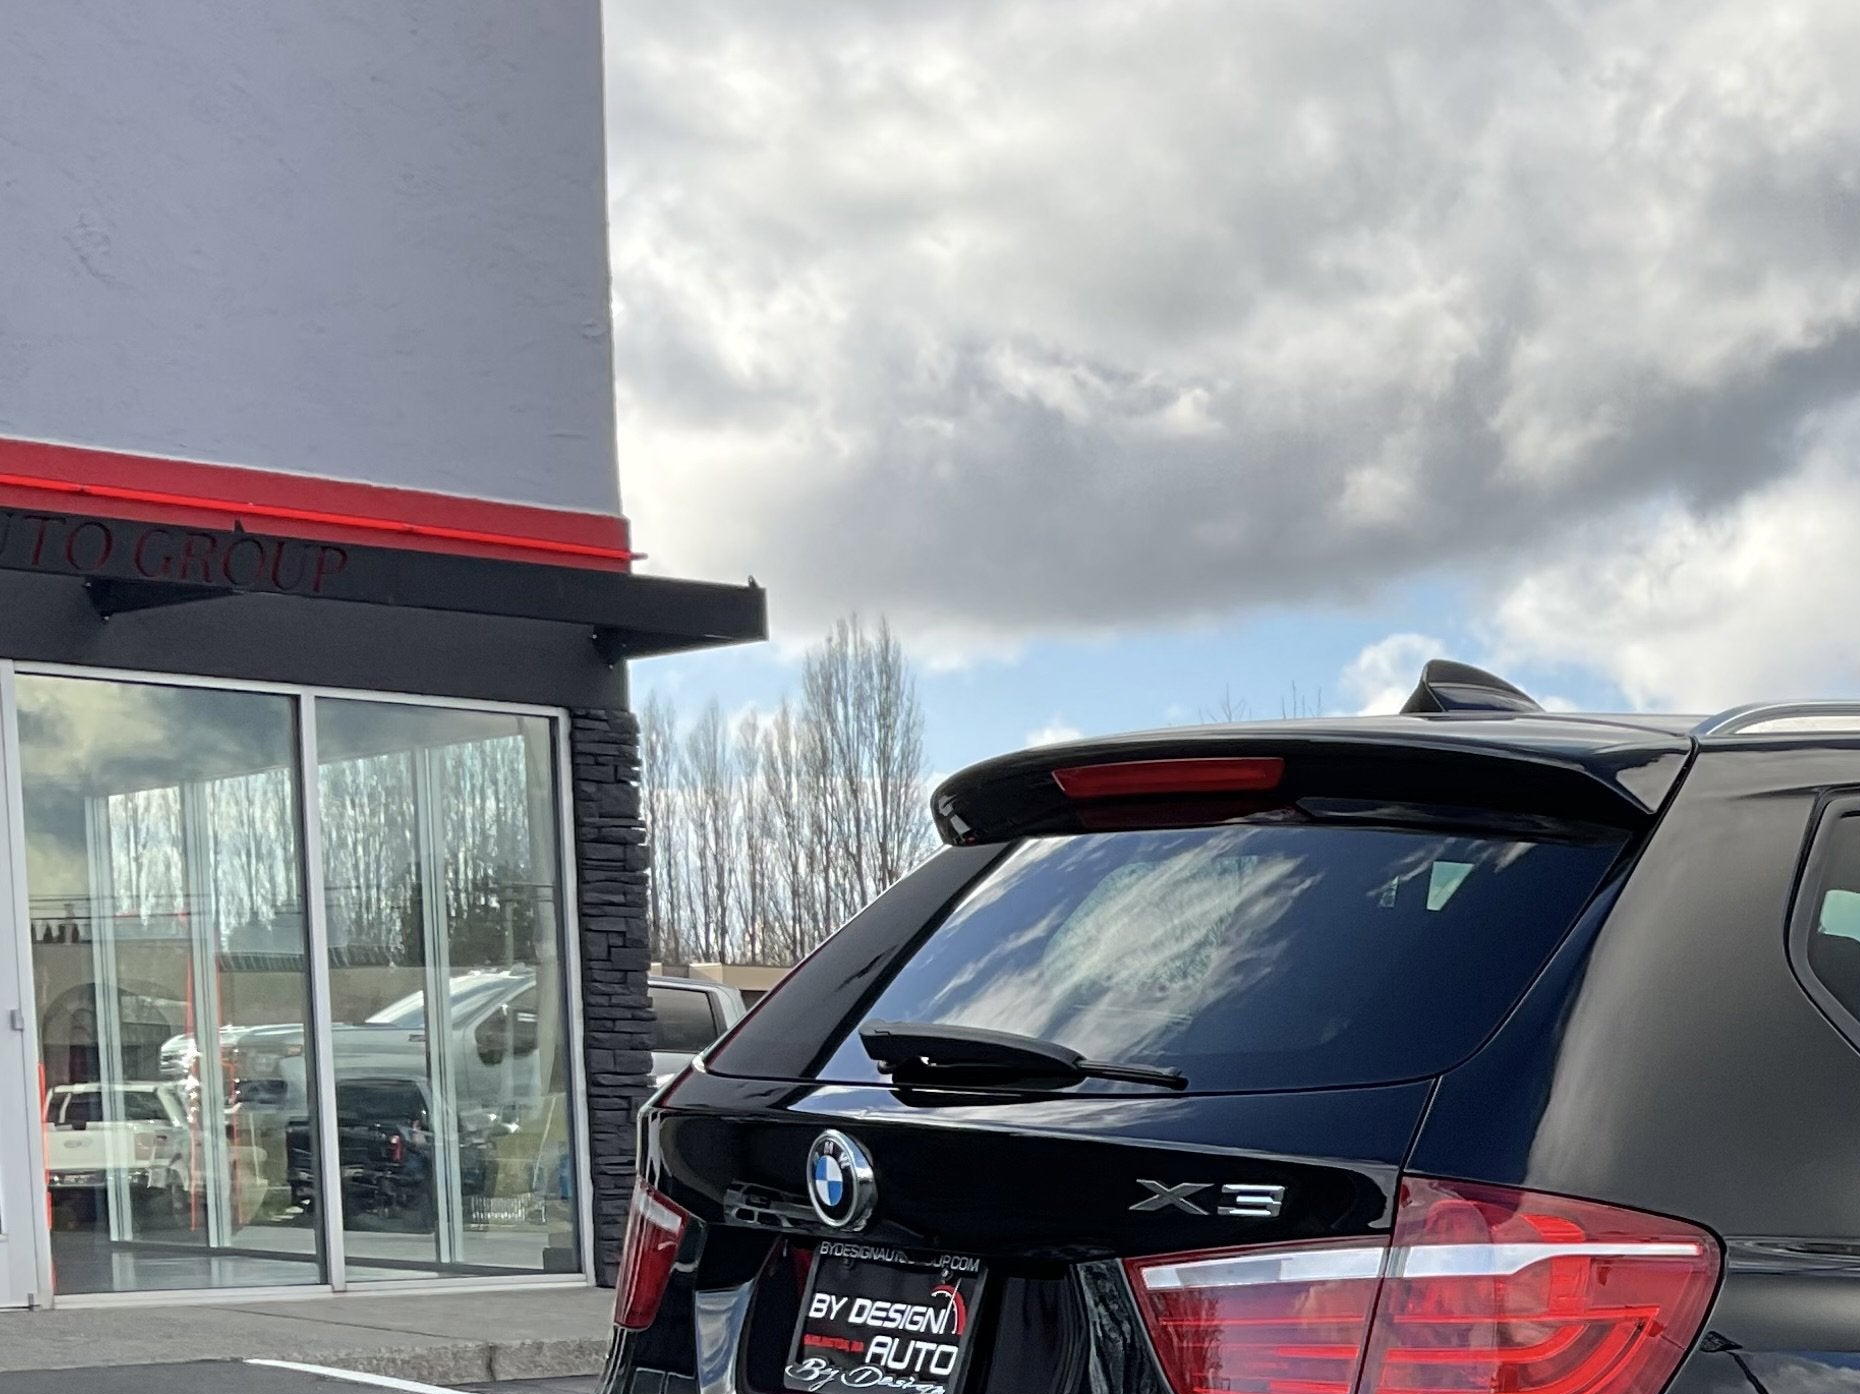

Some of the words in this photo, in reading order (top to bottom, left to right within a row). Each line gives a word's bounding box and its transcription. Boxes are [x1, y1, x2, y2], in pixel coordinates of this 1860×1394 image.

[134, 529, 348, 593] GROUP
[1128, 1178, 1286, 1217] X3
[808, 1292, 848, 1320] BY
[848, 1298, 950, 1334] DESIGN
[784, 1357, 840, 1392] By
[864, 1335, 959, 1376] AUTO
